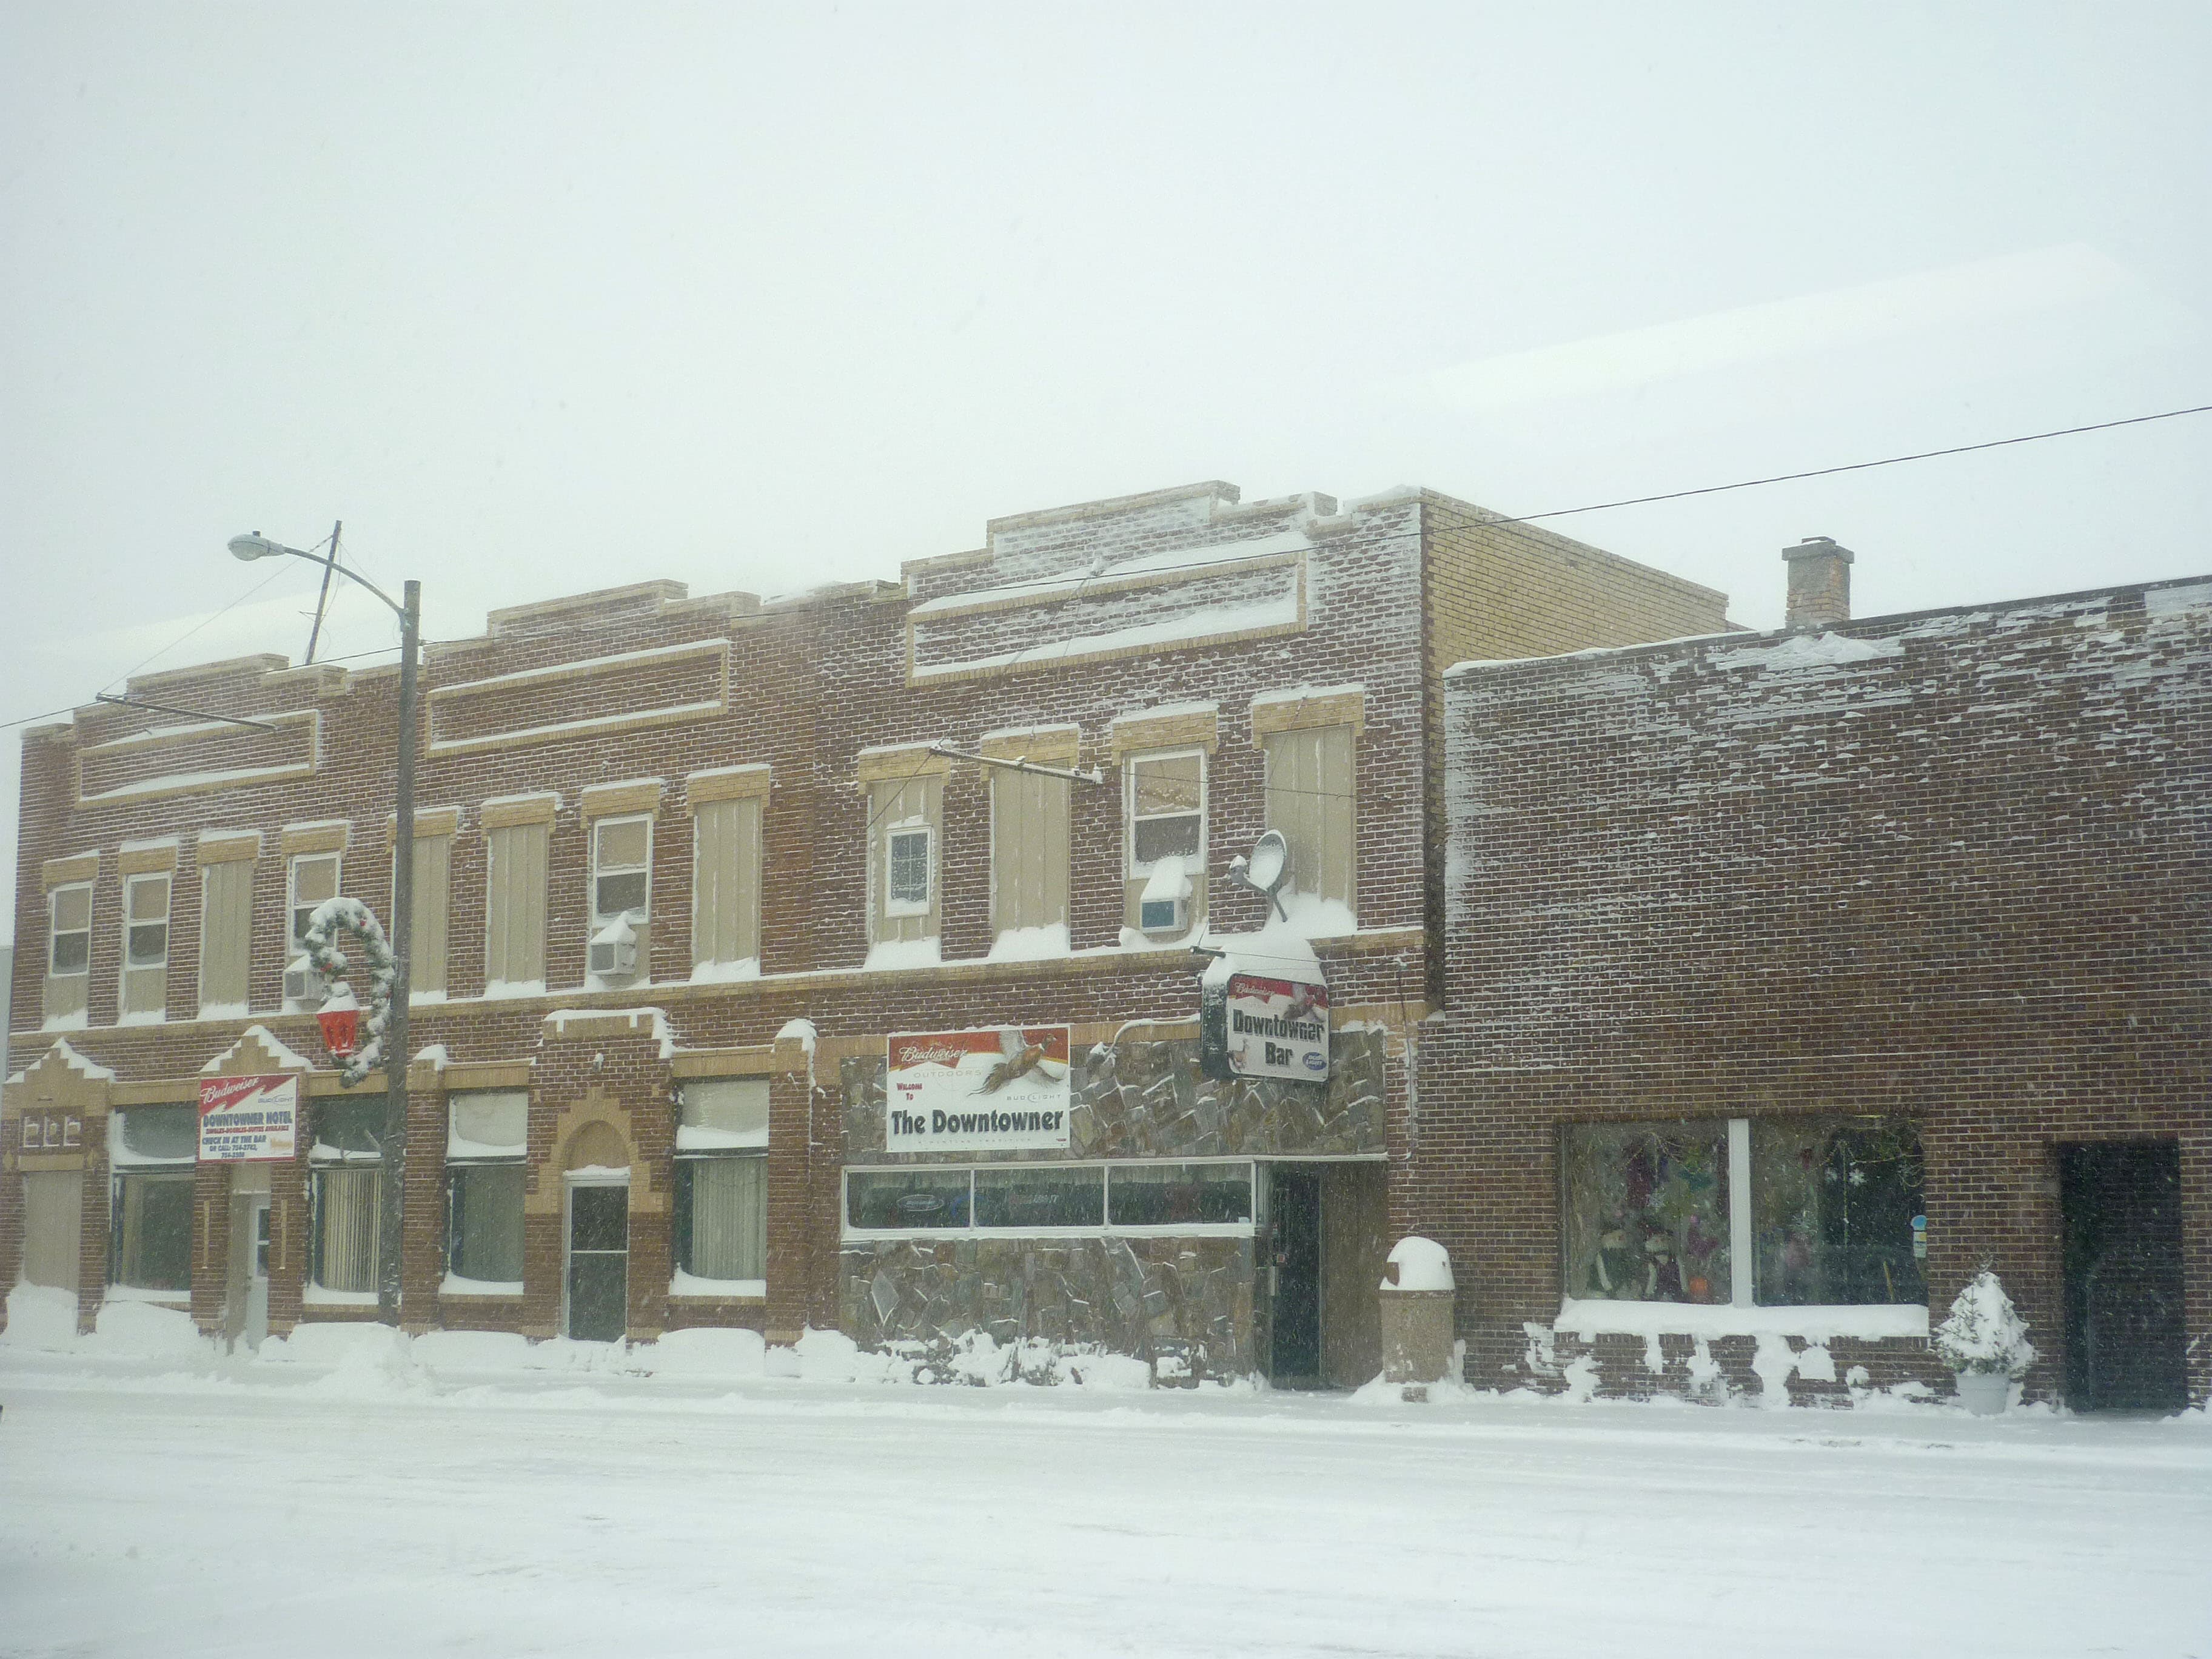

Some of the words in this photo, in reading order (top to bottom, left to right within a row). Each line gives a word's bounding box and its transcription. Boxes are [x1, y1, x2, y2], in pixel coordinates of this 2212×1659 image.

[1233, 1009, 1324, 1041] Downtowner
[899, 1045, 968, 1062] Budweiser
[1265, 1042, 1294, 1065] Bar
[914, 1070, 981, 1078] OUTDOORS
[199, 1077, 260, 1104] Budweiser
[204, 1113, 264, 1127] DOWNTOWNER
[266, 1111, 292, 1125] HOTEL
[891, 1110, 926, 1134] The
[932, 1109, 1063, 1133] Downtowner
